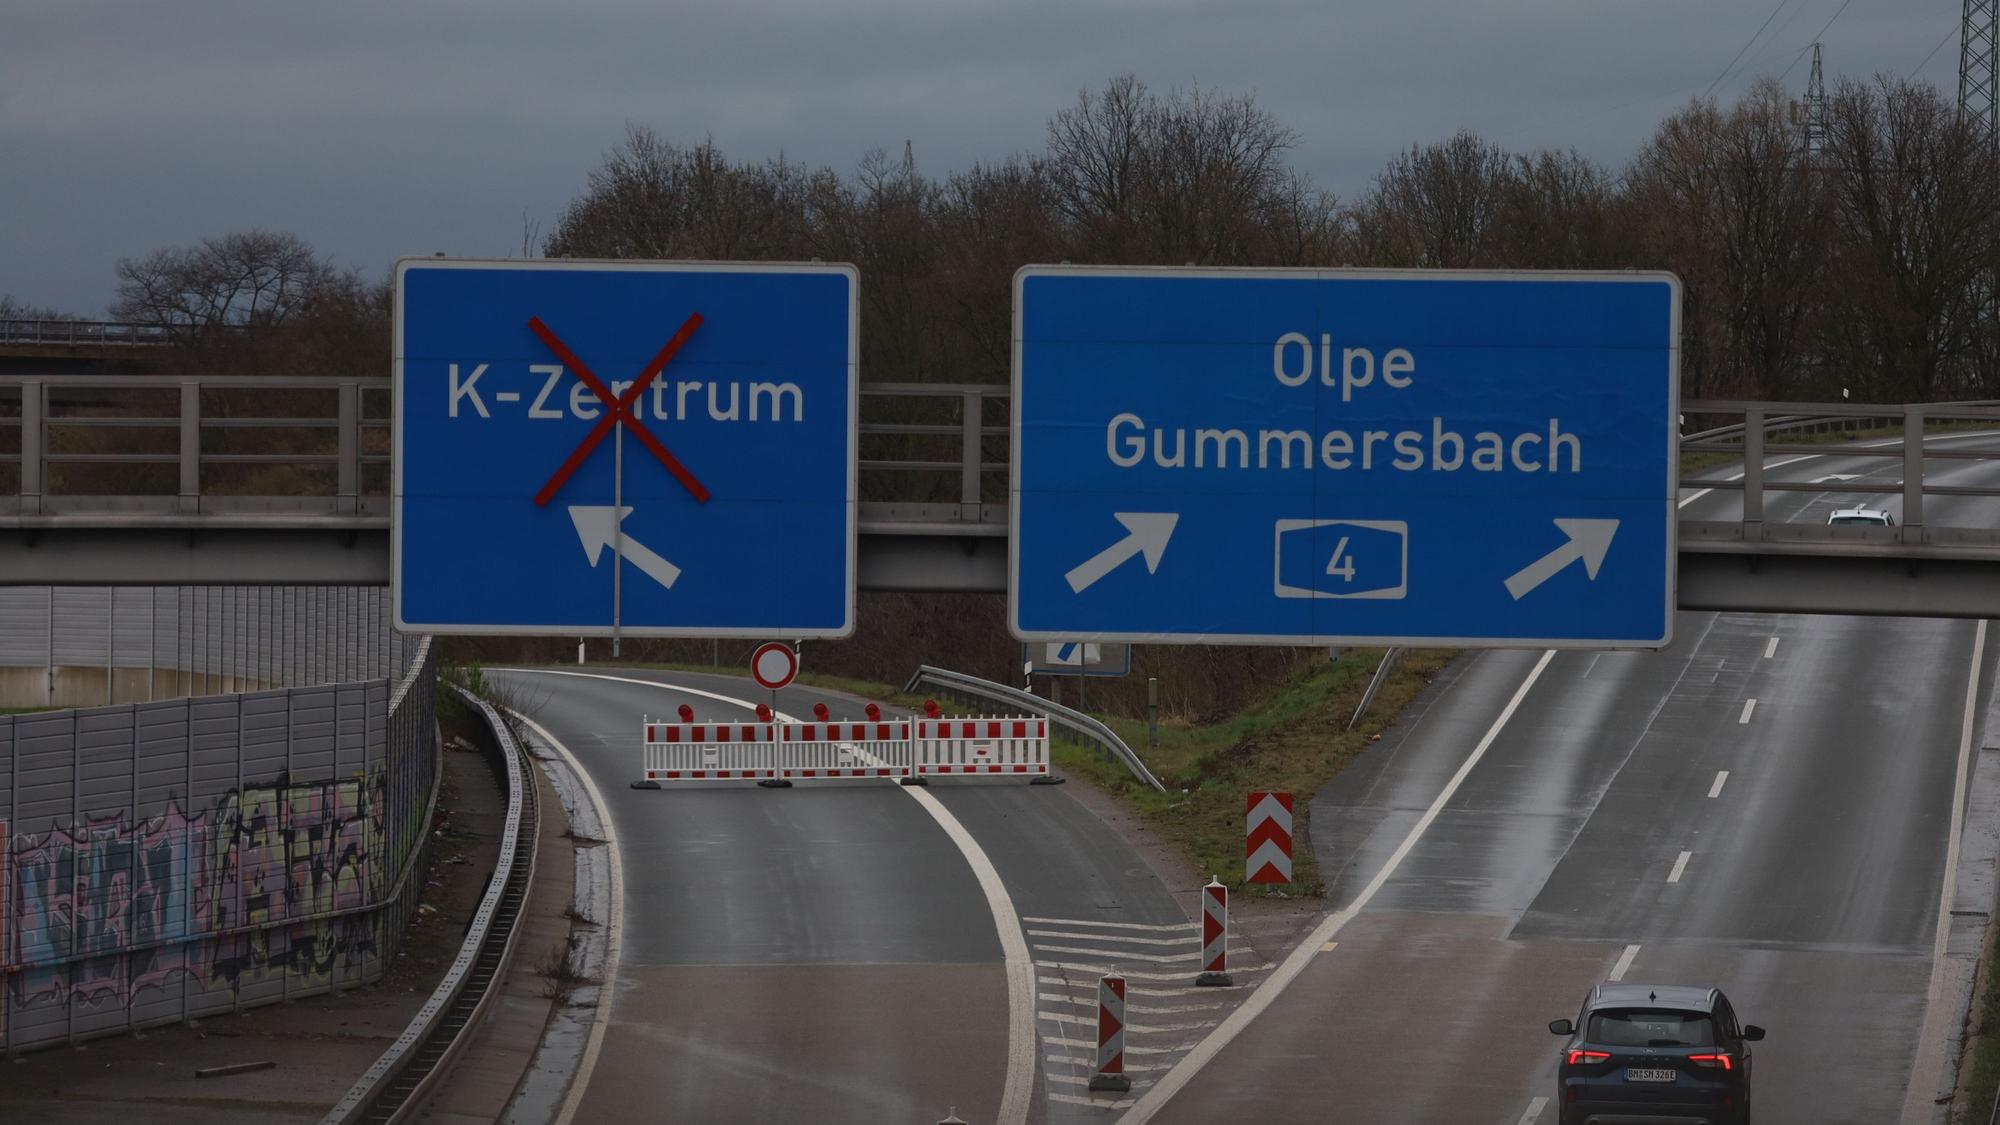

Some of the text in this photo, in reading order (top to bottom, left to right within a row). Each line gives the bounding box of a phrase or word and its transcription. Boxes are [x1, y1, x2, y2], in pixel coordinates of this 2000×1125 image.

[1274, 332, 1415, 401] Olpe
[1106, 412, 1583, 473] Gummersbach
[1326, 536, 1356, 582] 4
